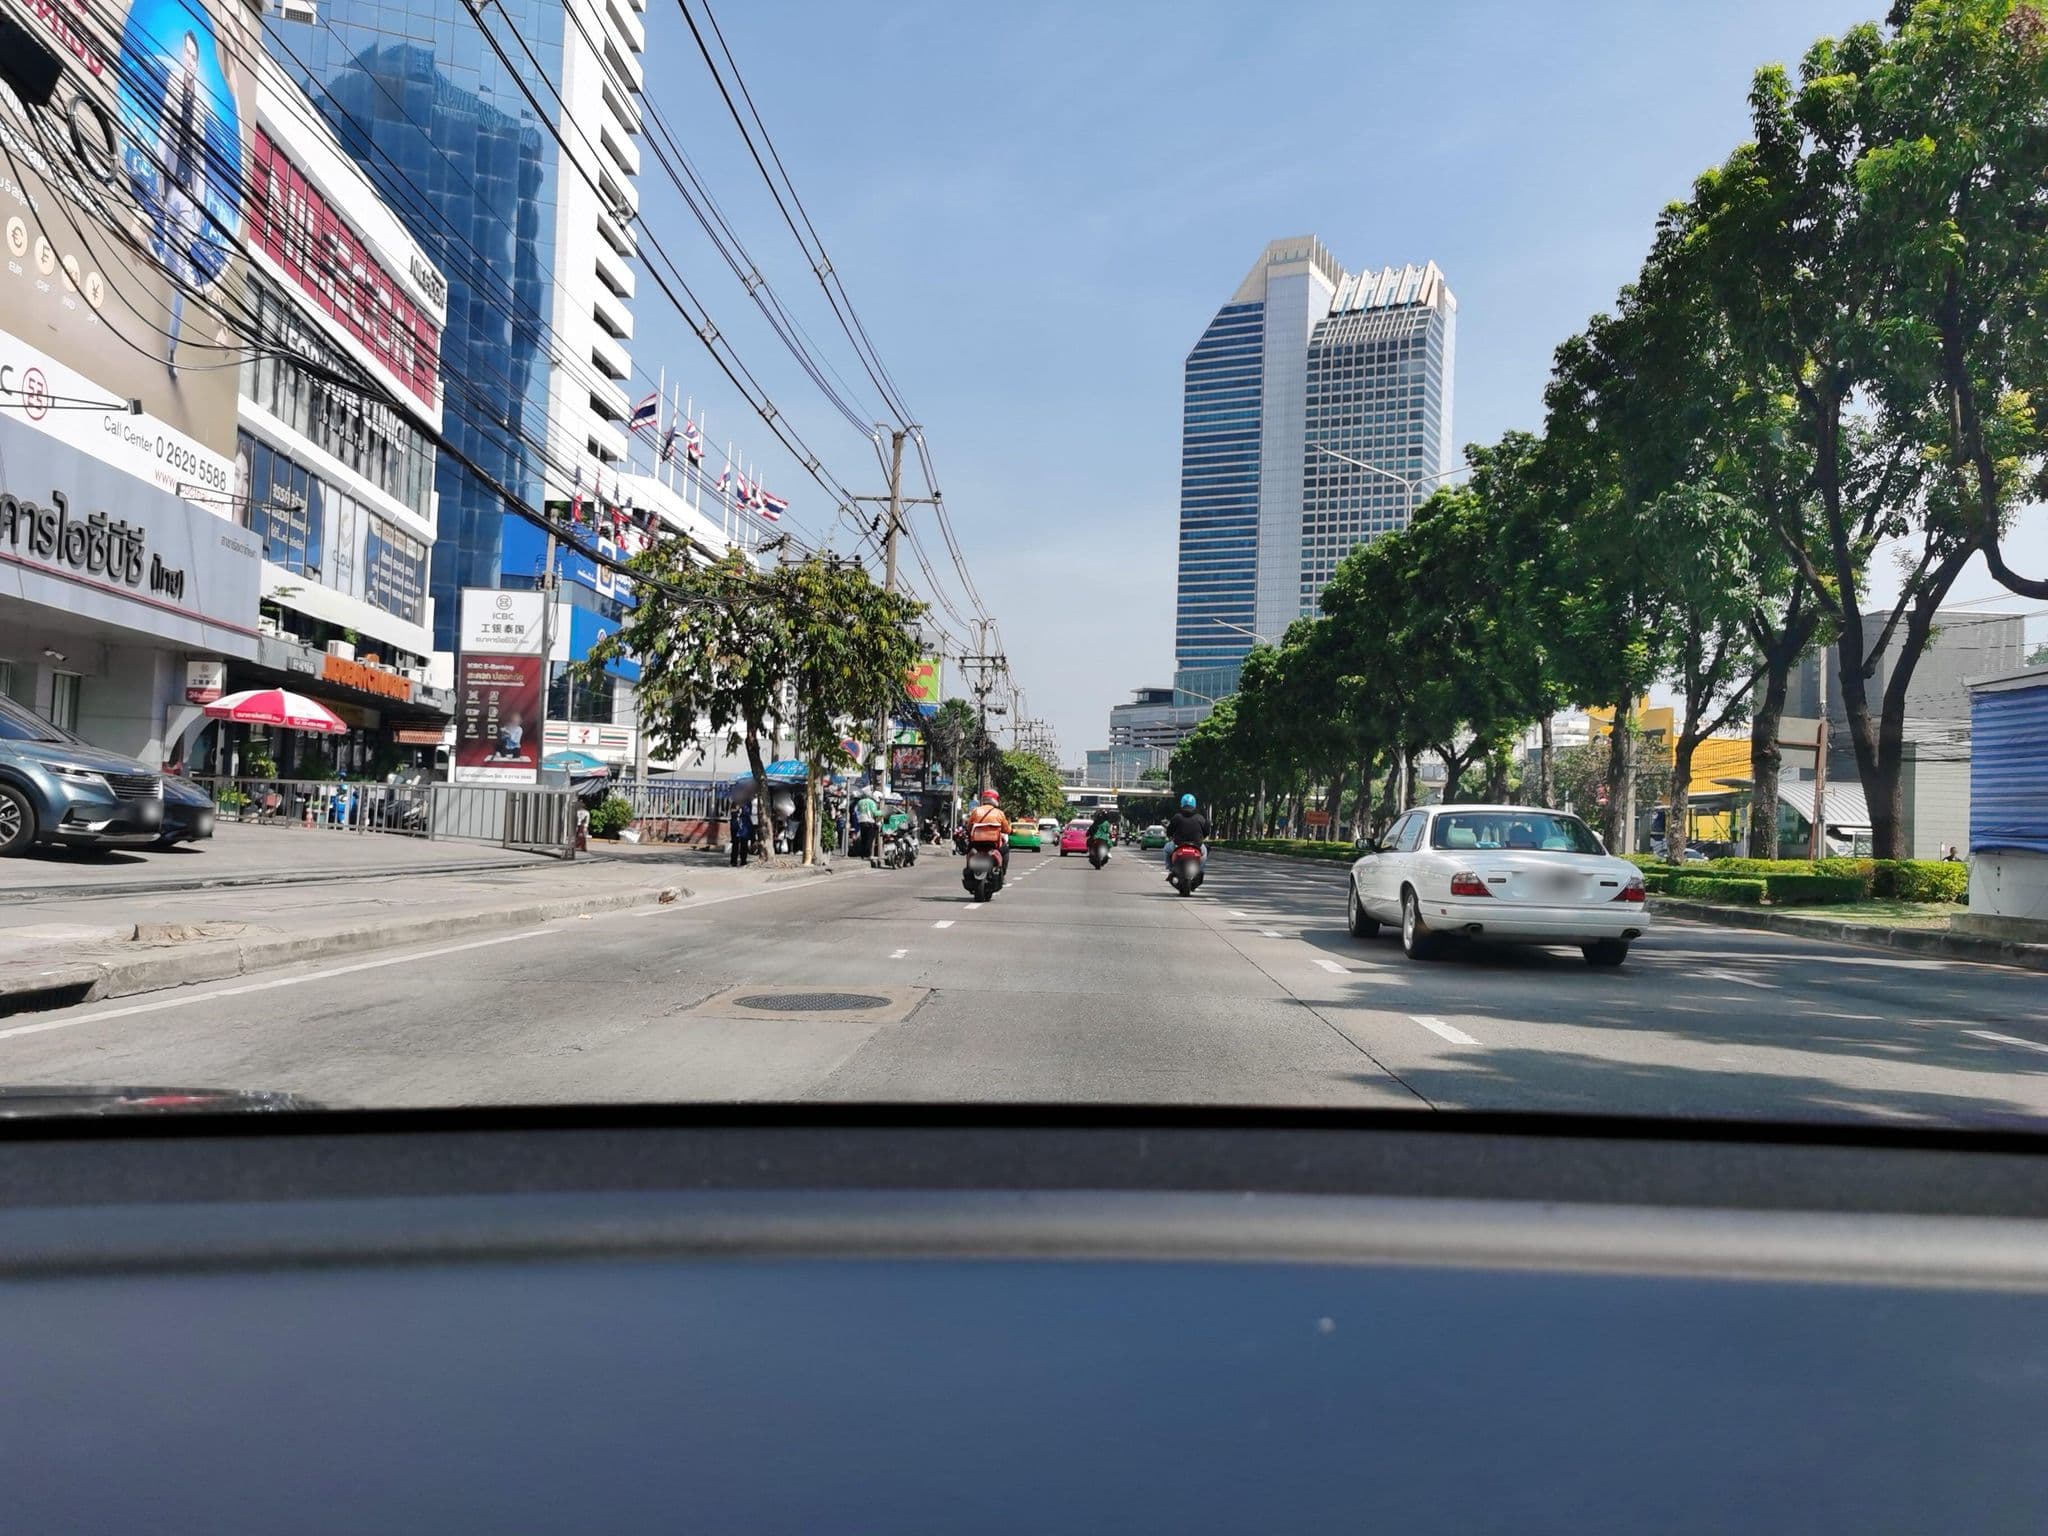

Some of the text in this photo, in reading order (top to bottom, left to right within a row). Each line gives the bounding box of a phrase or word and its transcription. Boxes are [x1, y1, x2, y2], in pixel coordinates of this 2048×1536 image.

[103, 415, 228, 491] Call Center 0 2629 5588
[481, 623, 525, 634] 工银泰国
